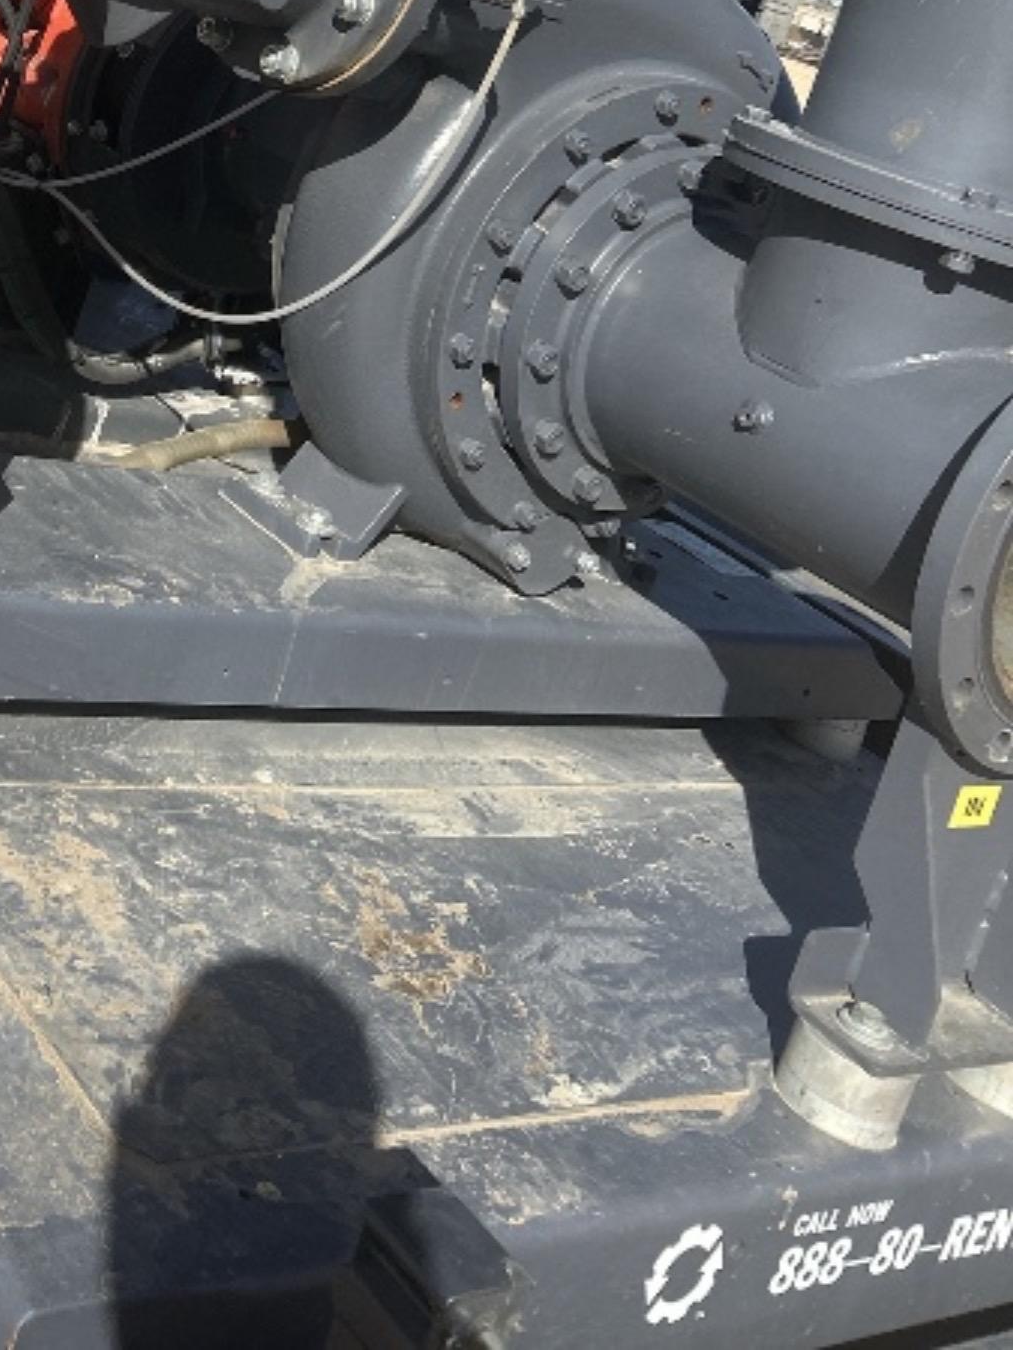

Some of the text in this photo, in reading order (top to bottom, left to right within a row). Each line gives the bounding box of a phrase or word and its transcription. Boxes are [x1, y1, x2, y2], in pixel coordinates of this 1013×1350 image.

[793, 1199, 894, 1237] CALL NOW
[768, 1207, 1013, 1296] 888-80-REN
